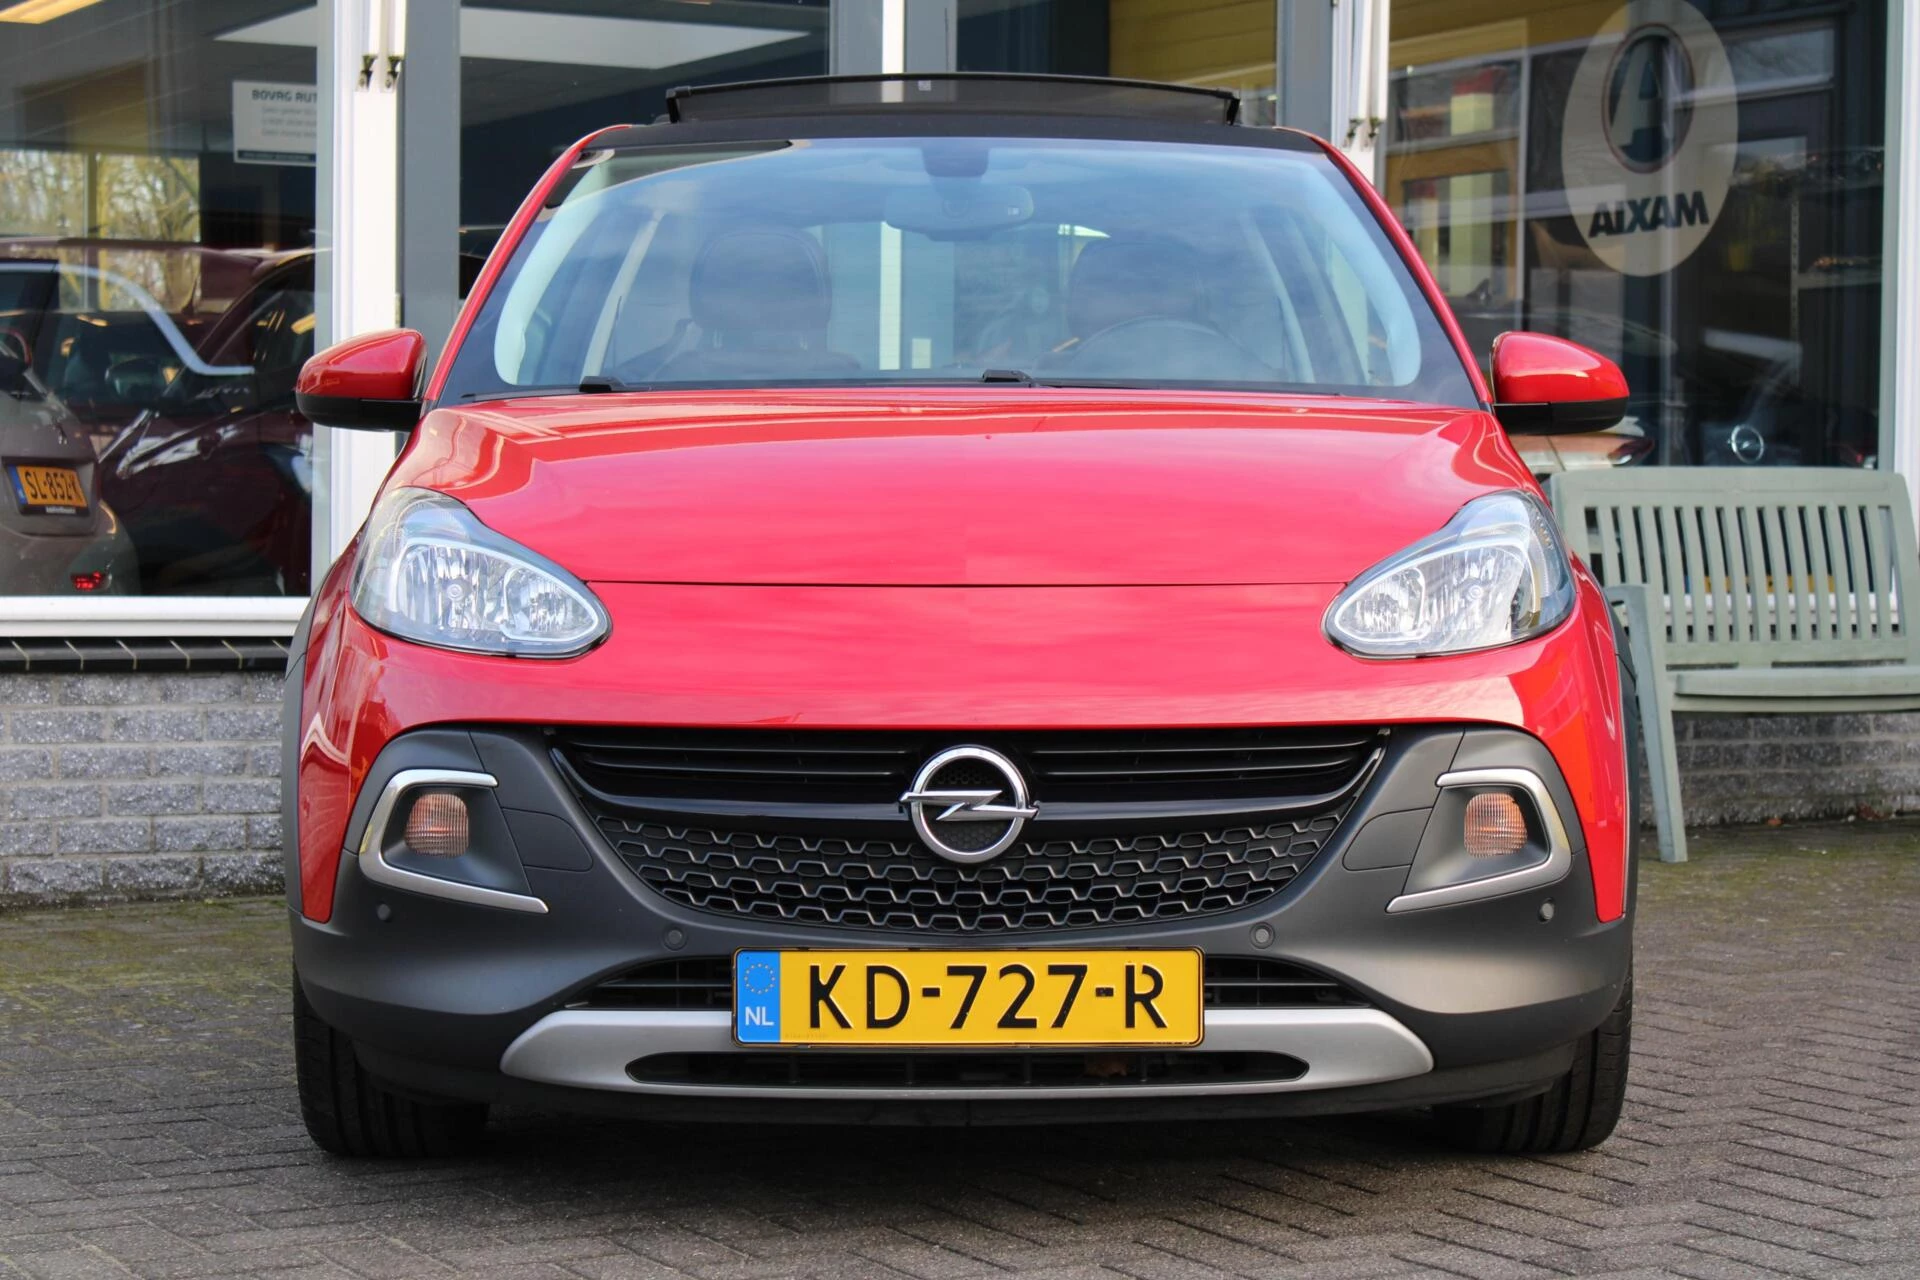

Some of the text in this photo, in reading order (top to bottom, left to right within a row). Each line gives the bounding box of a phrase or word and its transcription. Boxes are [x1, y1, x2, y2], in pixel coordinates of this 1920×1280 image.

[251, 89, 292, 101] BOVAG
[809, 964, 1168, 1030] KD-727-R
[744, 1007, 774, 1027] NL
